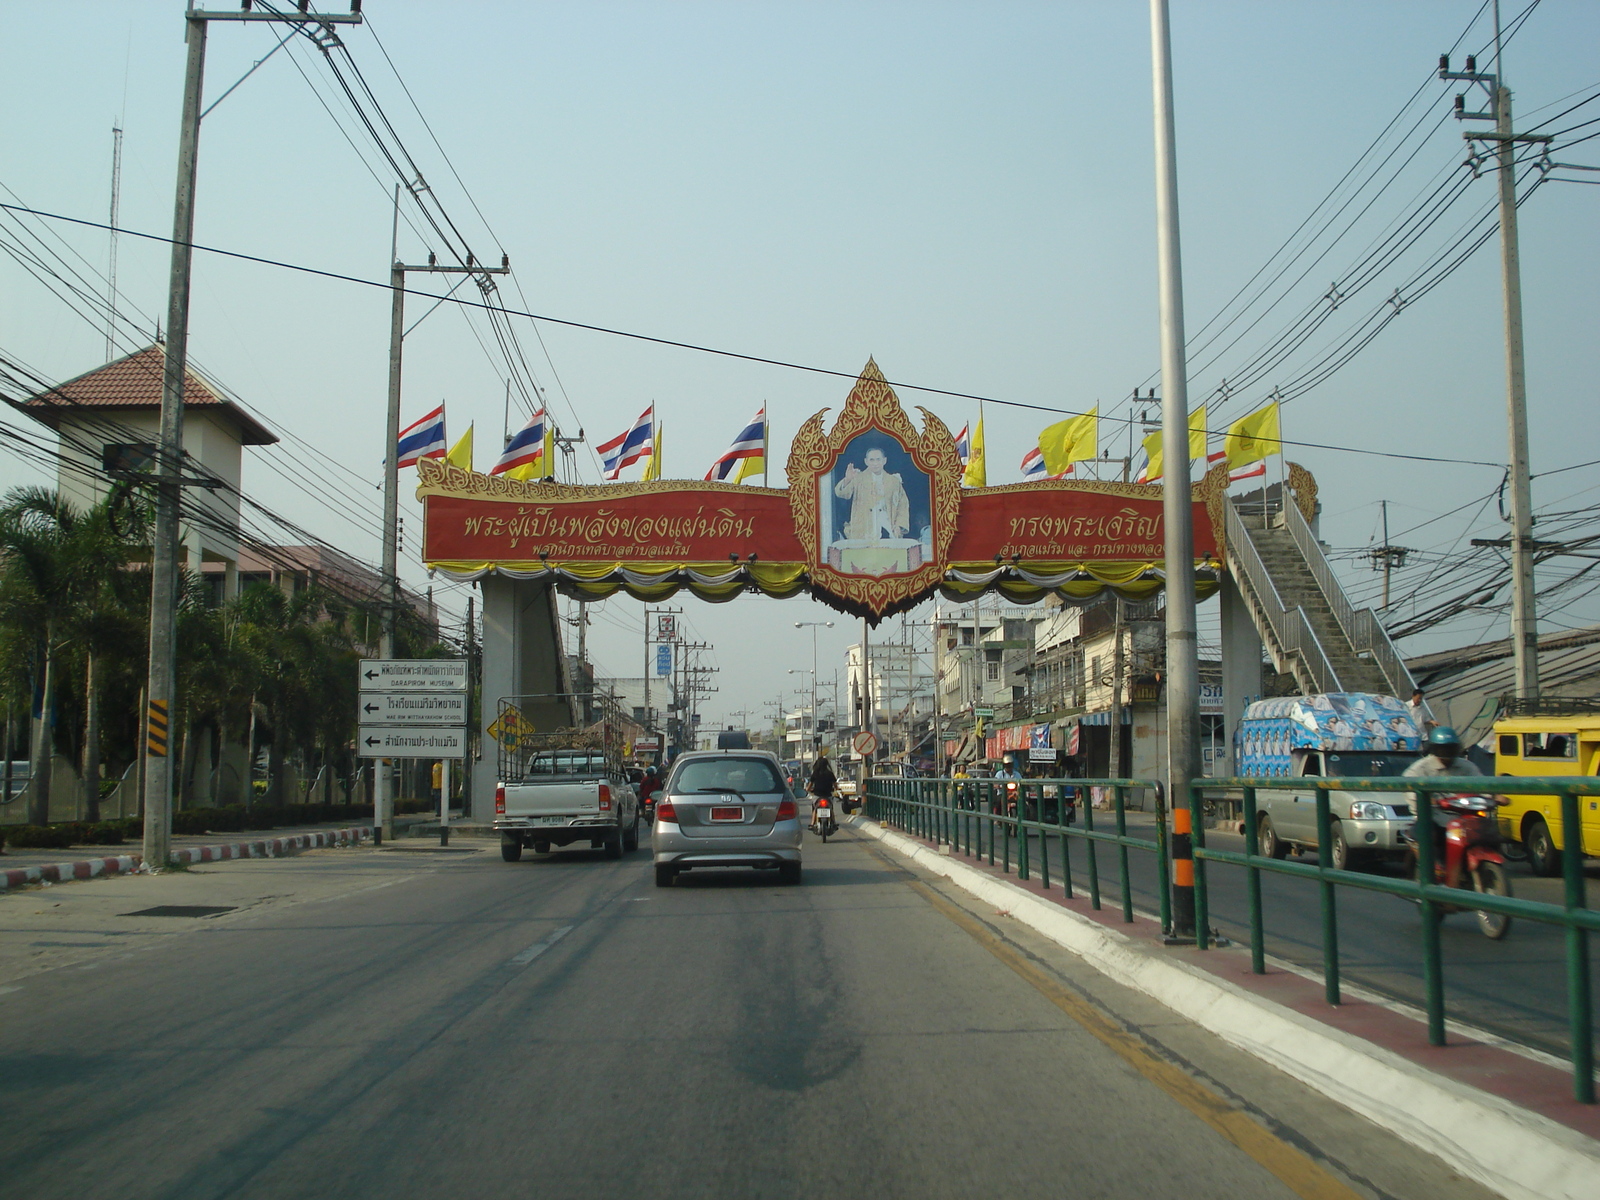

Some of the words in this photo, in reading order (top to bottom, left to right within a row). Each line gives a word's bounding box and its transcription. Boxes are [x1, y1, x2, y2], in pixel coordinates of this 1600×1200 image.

[464, 506, 754, 549] พระผู้เป็นพลังของแผ่นดิน
[1010, 508, 1162, 540] ทรงพระเจริญ
[532, 537, 692, 558] พสกนิกรเทศบาลตำบลแม่ริม
[1000, 537, 1065, 557] อำเภอแม่ริม
[1068, 544, 1089, 557] และ
[386, 696, 462, 709] โรงเรียนแม่ริมวิทยาคม
[385, 734, 458, 747] สำนักงานประปาแม่ริม
